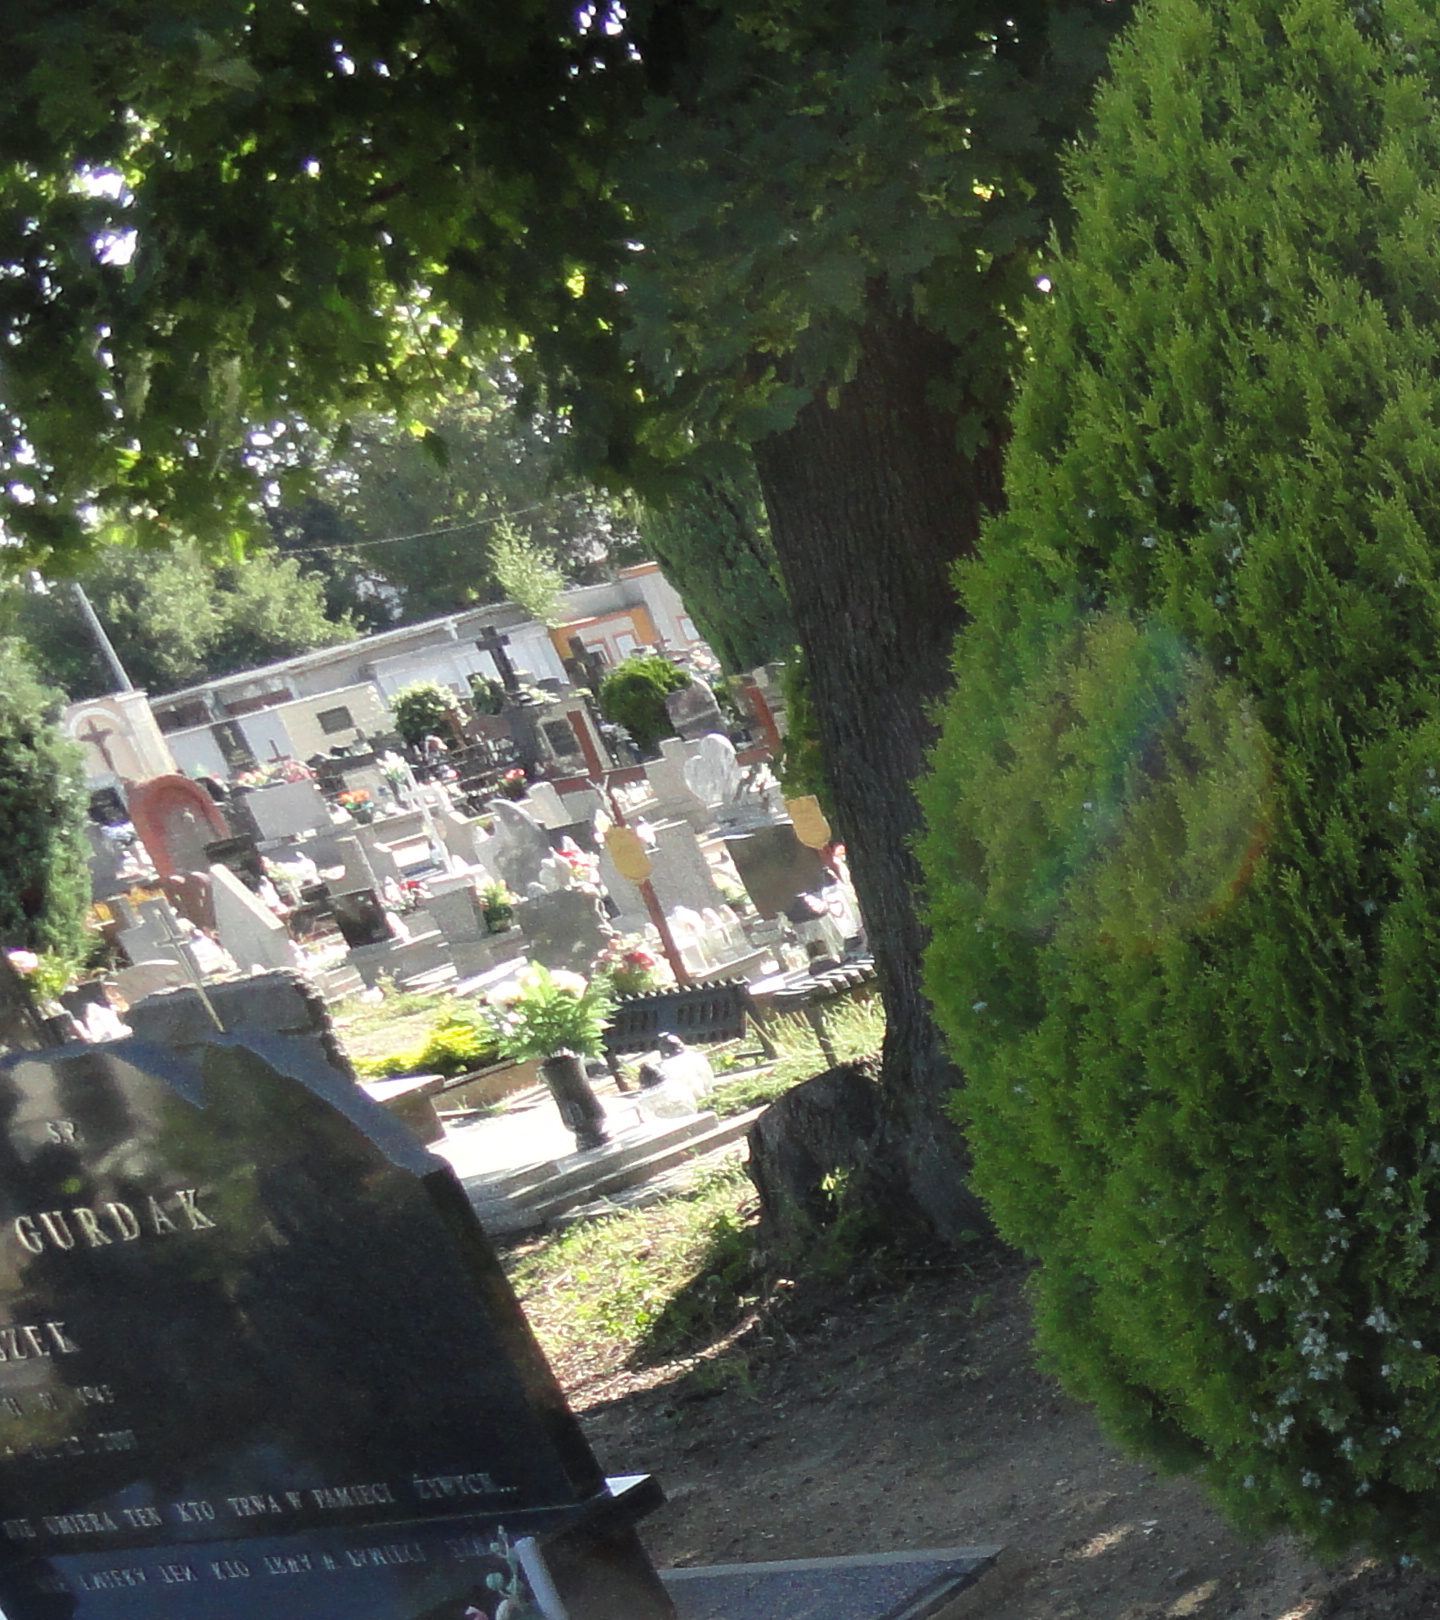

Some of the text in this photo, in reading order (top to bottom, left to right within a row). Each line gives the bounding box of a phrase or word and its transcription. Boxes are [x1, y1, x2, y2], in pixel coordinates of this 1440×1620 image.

[14, 1188, 217, 1255] GURDAK
[174, 1500, 217, 1523] KTO
[226, 1494, 284, 1518] TRWA
